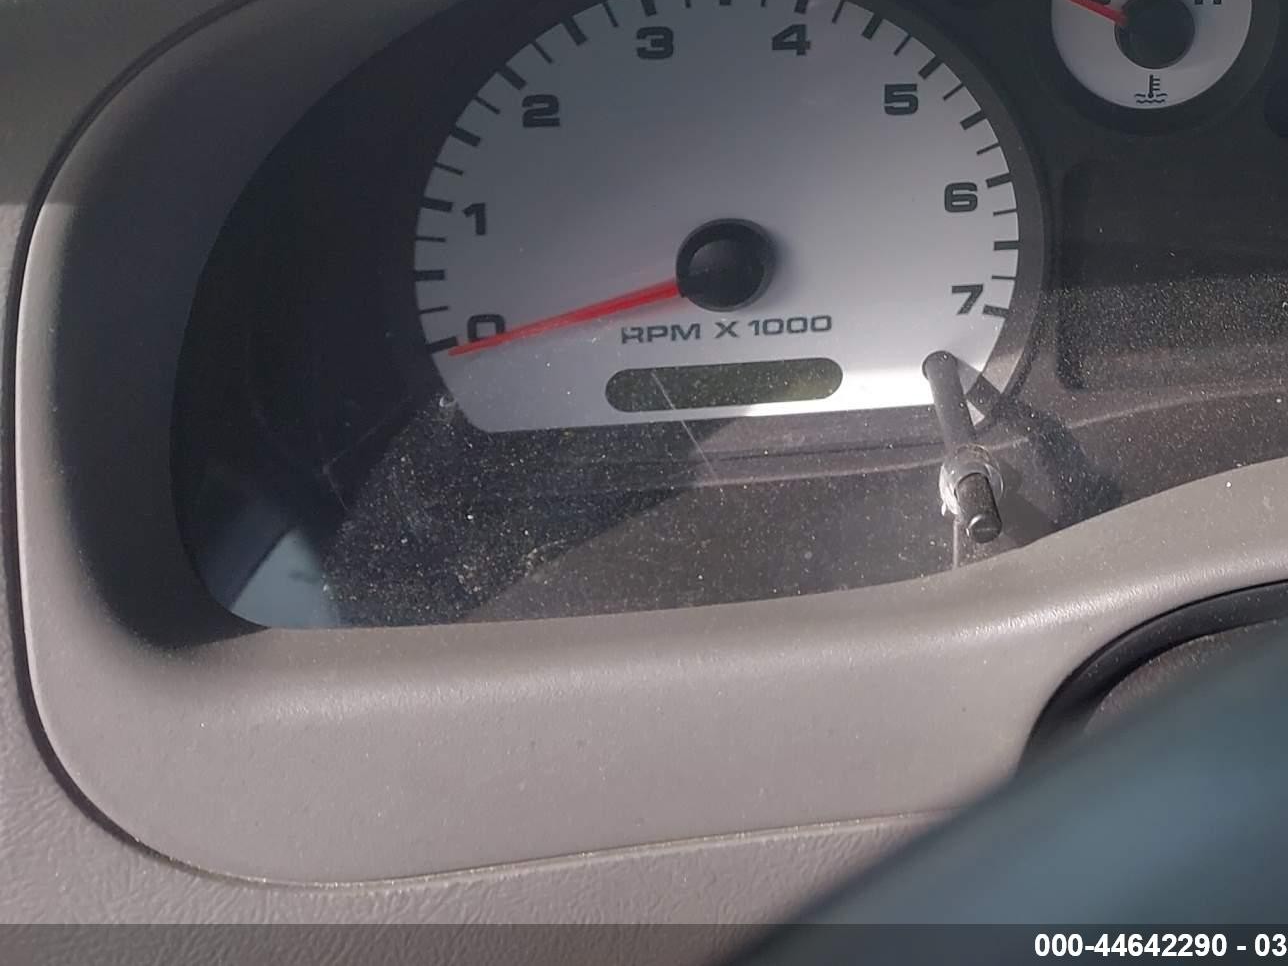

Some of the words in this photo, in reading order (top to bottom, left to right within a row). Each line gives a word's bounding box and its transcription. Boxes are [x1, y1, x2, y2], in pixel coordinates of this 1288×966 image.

[636, 27, 674, 59] 3
[772, 25, 810, 55] 4
[522, 94, 560, 127] 2
[883, 83, 918, 115] 5
[944, 182, 978, 212] 6
[464, 203, 487, 234] 1
[952, 284, 984, 315] 7
[467, 314, 506, 342] 0
[621, 323, 701, 344] RPM
[715, 320, 740, 339] X
[748, 315, 833, 336] 1000
